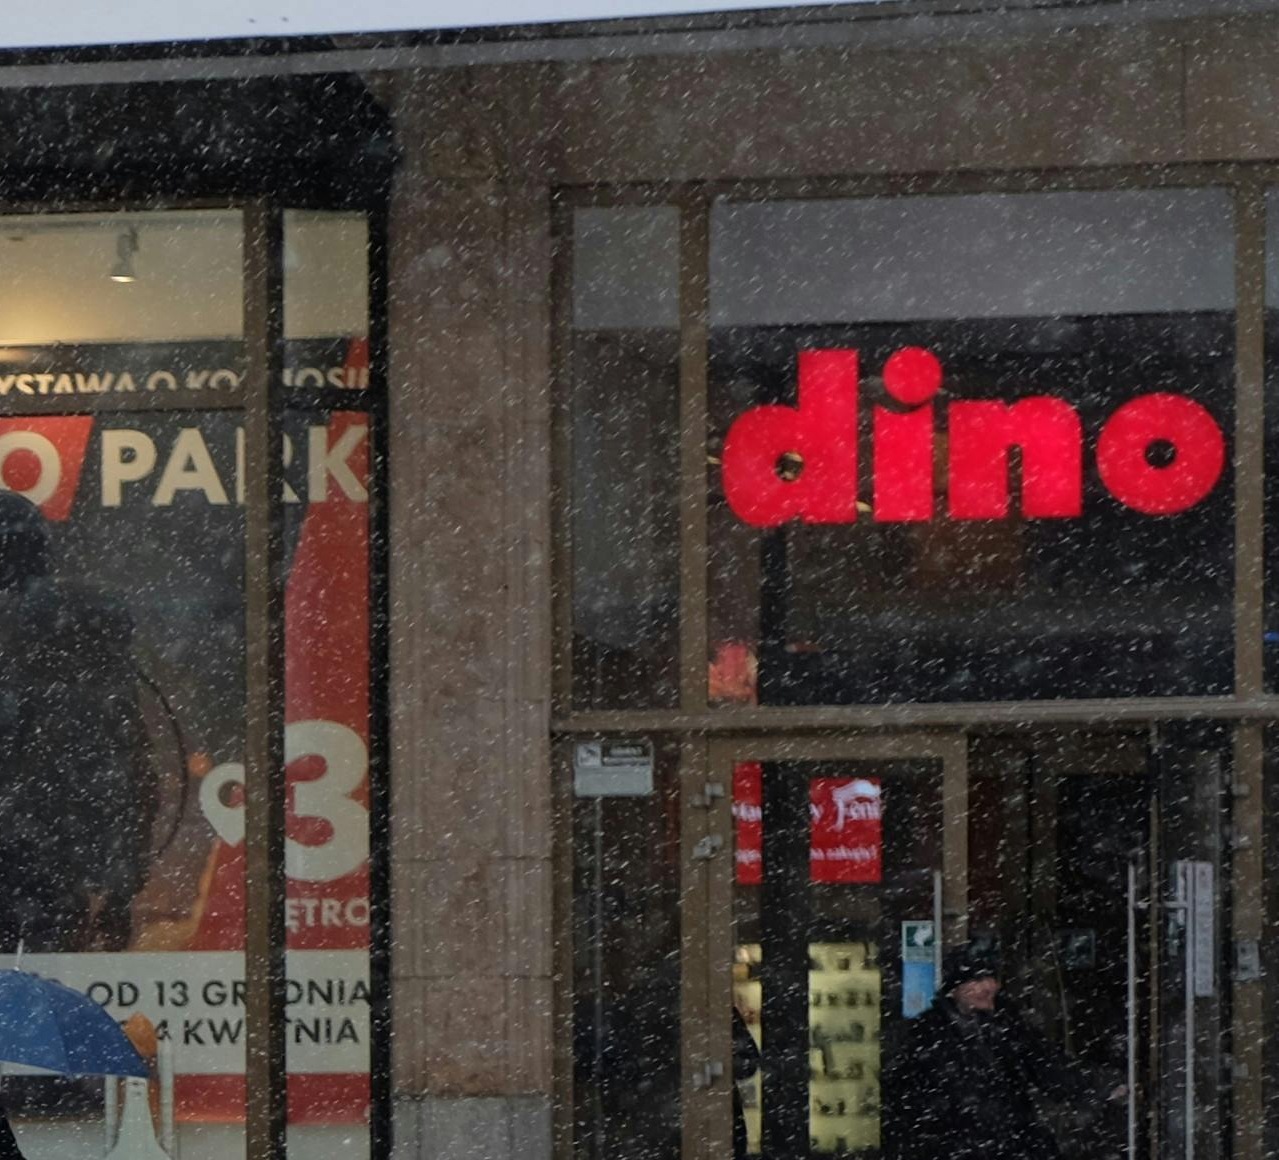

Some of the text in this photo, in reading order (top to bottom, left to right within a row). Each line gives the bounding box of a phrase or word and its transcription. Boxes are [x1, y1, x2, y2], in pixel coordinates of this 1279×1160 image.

[721, 345, 1227, 528] dino
[284, 720, 369, 882] 3
[87, 979, 371, 1007] OD 13 GRDNIA
